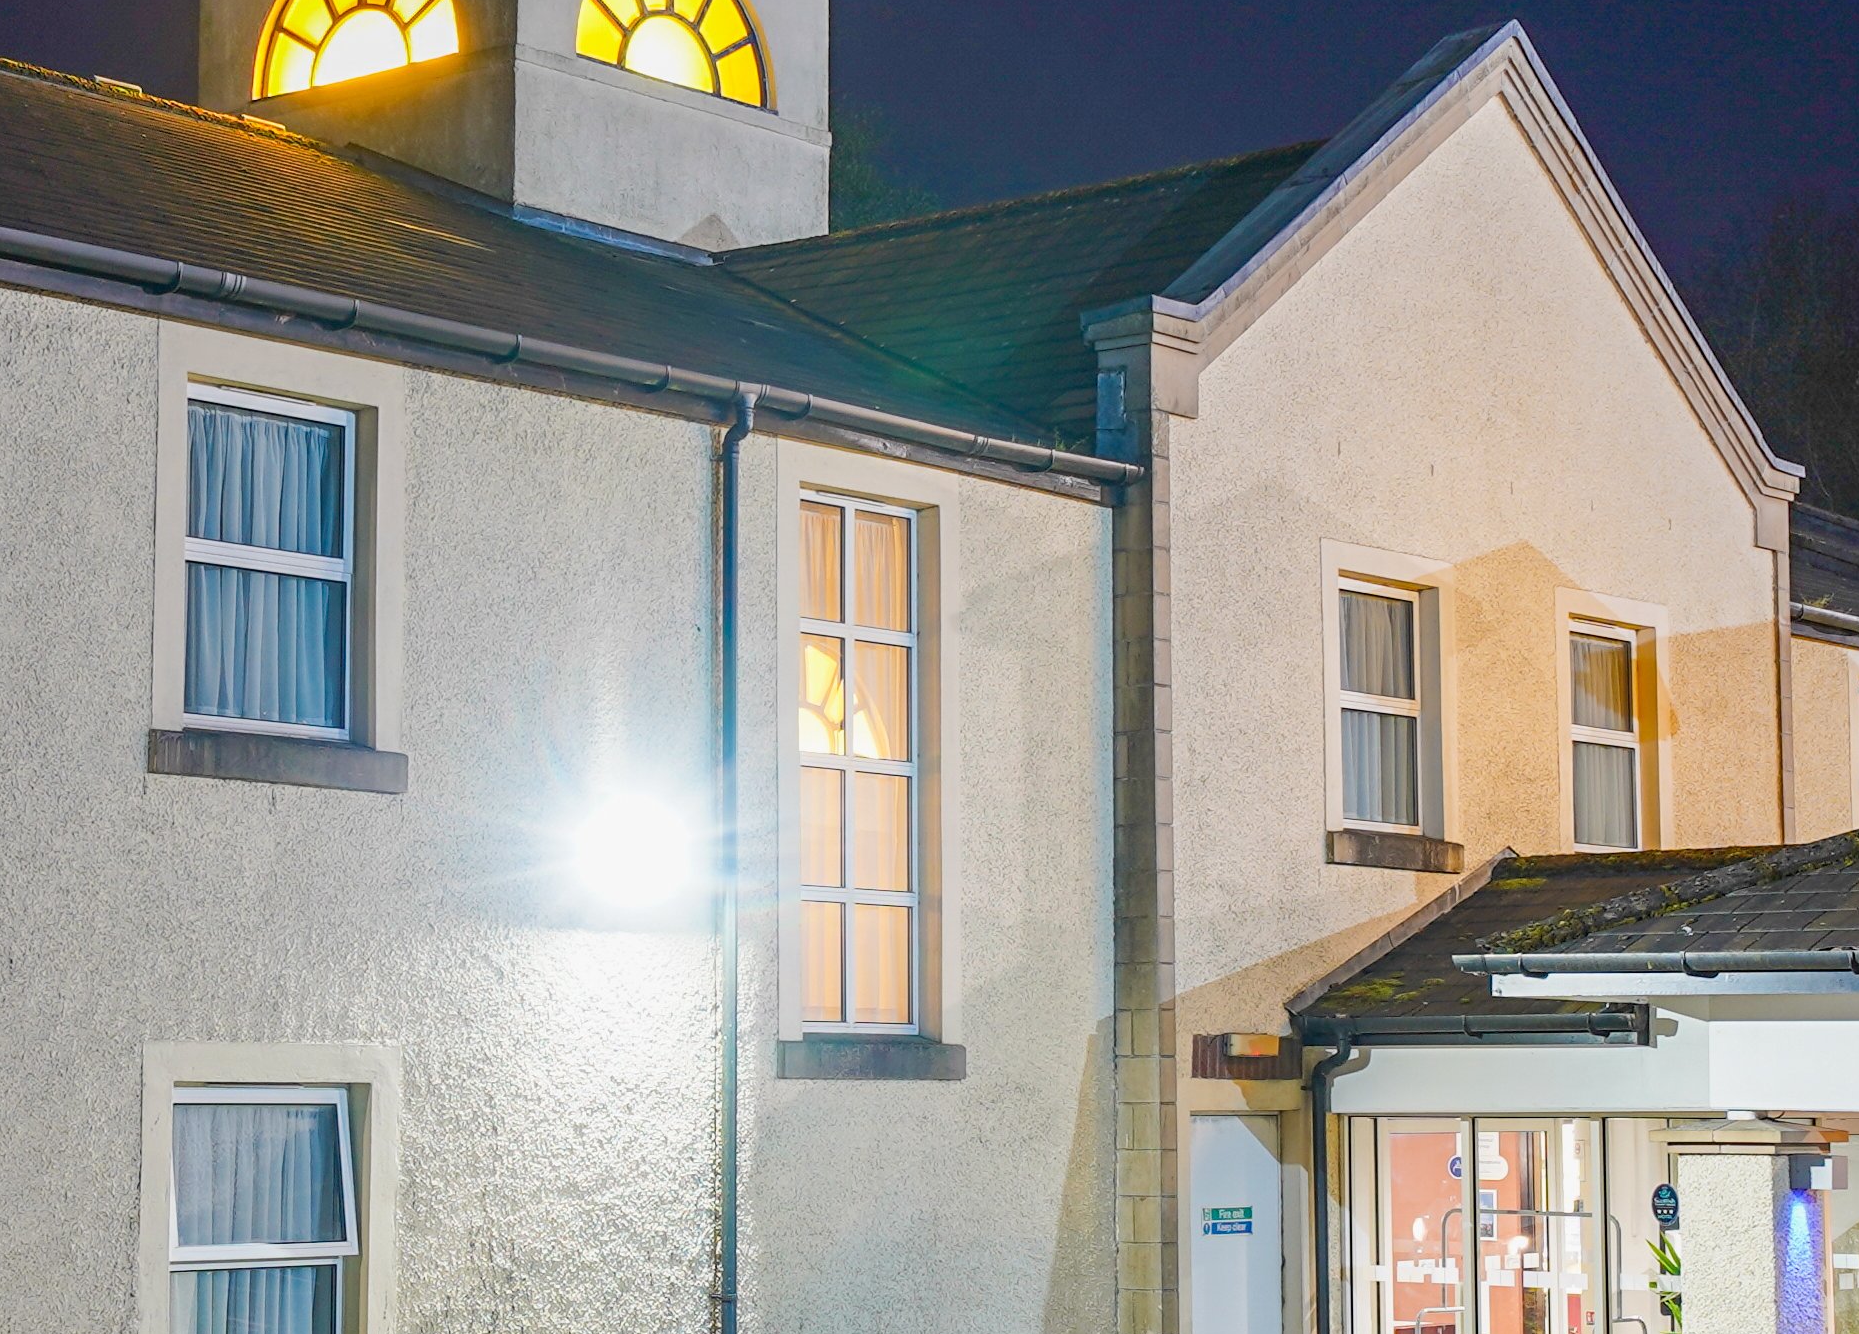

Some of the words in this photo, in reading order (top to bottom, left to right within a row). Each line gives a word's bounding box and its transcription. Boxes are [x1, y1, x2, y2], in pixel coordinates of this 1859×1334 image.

[1219, 1209, 1231, 1218] Fire
[1232, 1208, 1244, 1218] exit
[1217, 1223, 1231, 1233] Keep
[1232, 1222, 1247, 1232] clear
